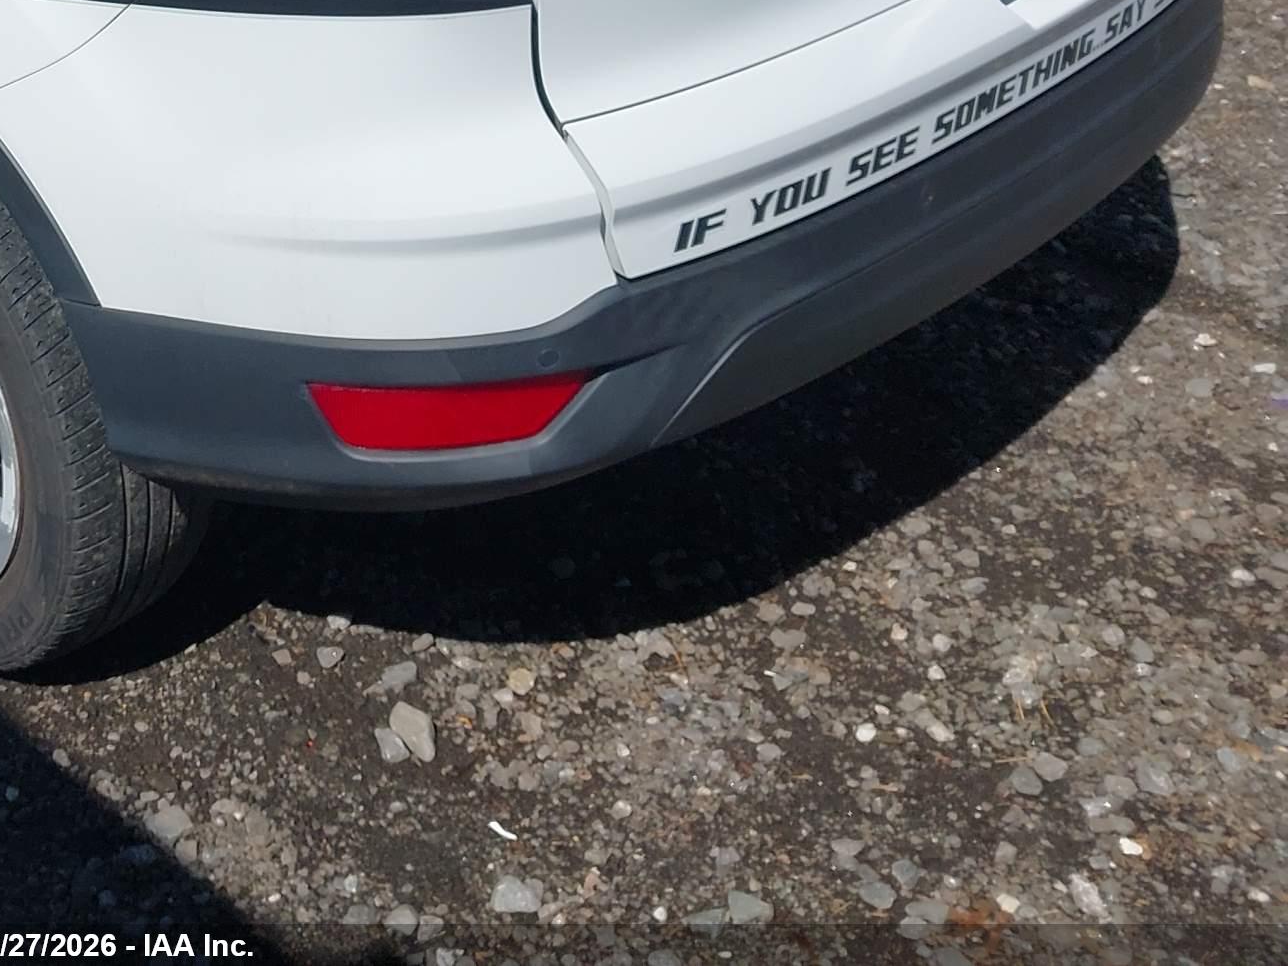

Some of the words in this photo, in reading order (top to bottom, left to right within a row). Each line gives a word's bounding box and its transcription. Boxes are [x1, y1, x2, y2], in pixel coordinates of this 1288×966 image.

[674, 209, 727, 253] IF
[750, 167, 833, 225] YOU
[845, 126, 920, 186] SEE
